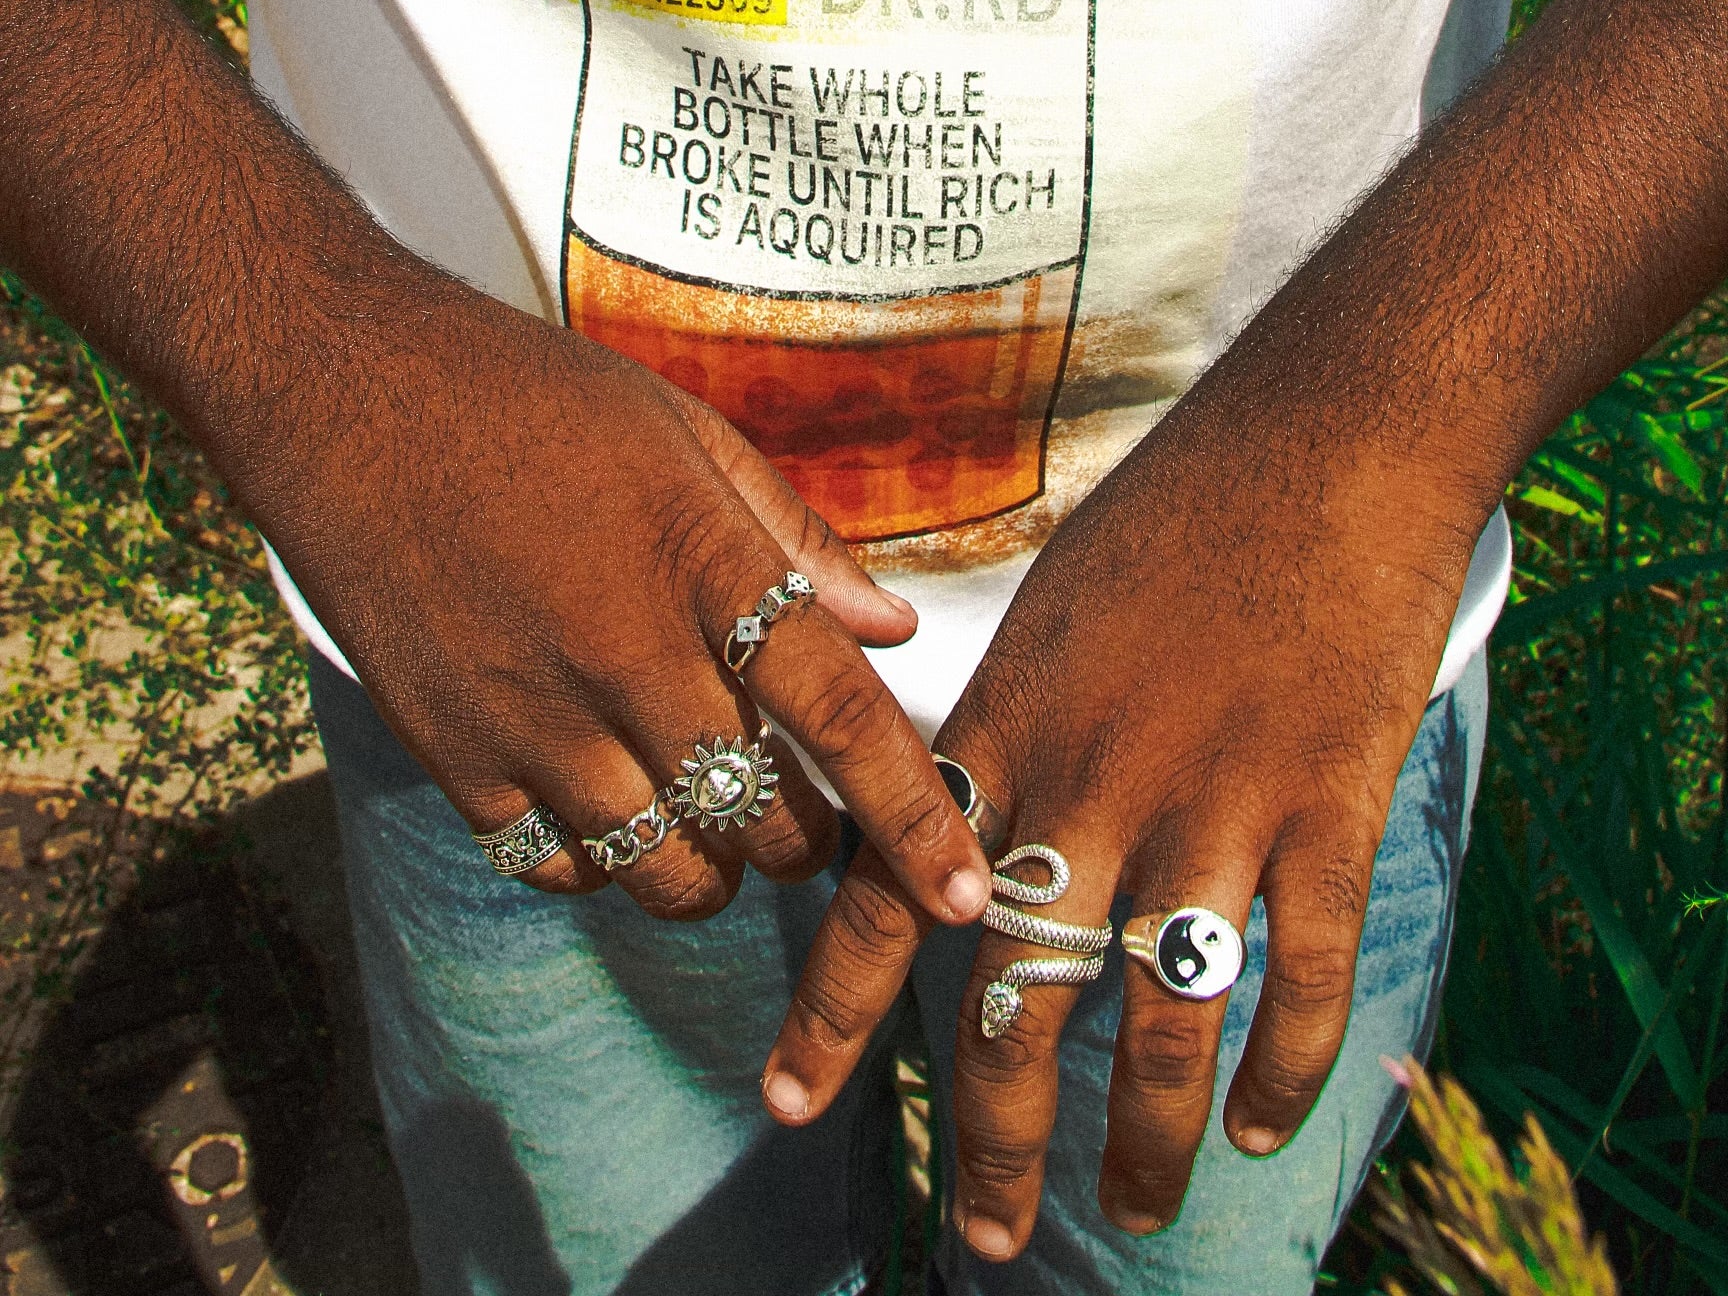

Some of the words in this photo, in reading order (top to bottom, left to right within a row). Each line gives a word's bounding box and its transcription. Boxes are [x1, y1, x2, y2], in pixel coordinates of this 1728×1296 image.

[681, 46, 793, 109] TAKE
[809, 66, 986, 117] WHOLE
[673, 86, 839, 162] BOTTLE
[854, 122, 1002, 169] WHEN
[619, 122, 771, 198] BROKE
[788, 161, 923, 219] UNTIL
[941, 168, 1056, 219] RICH
[680, 188, 721, 240] IS
[735, 202, 984, 268] AQQUIRED
